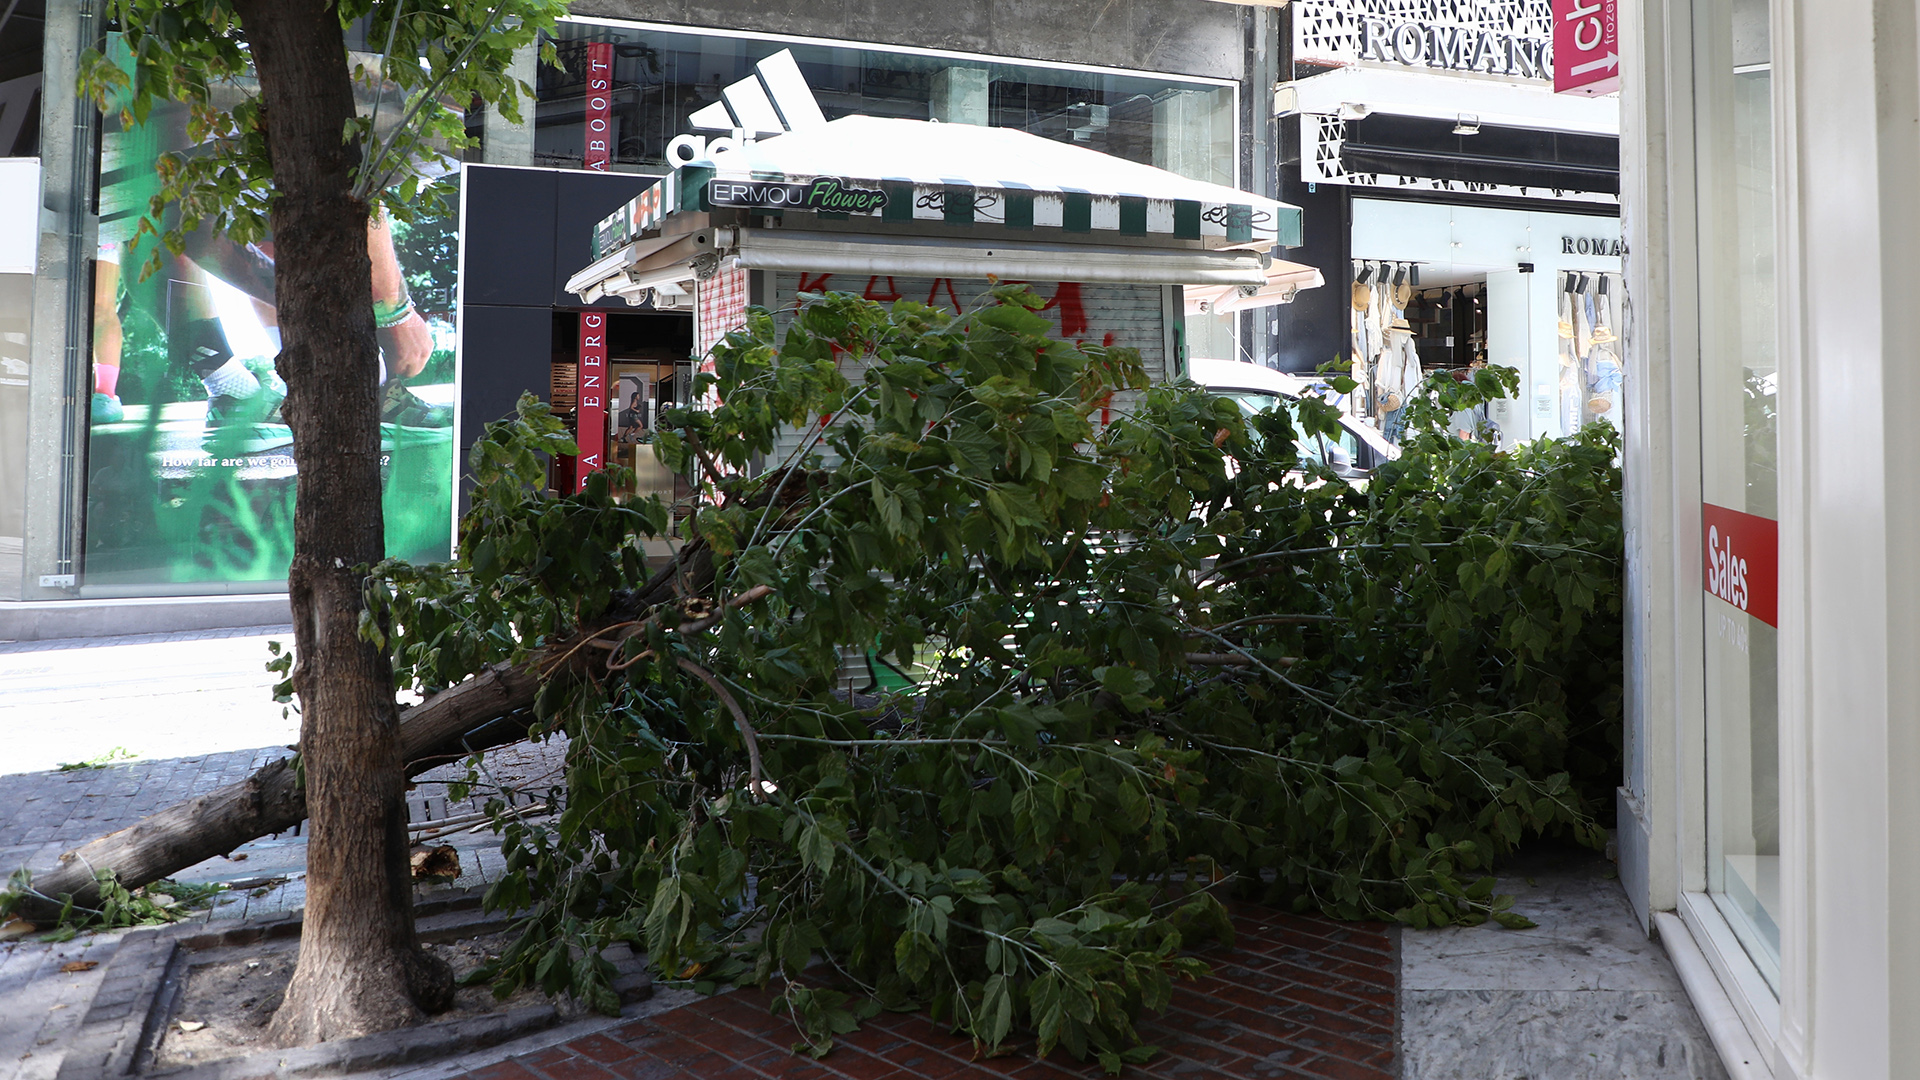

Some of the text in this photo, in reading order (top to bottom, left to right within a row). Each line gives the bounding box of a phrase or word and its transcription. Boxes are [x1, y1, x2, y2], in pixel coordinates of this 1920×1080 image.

[1604, 0, 1615, 45] froze
[590, 59, 607, 172] ABOOST
[714, 181, 884, 209] ERMOU Flower
[584, 314, 602, 408] ENERG
[162, 456, 195, 467] How
[198, 455, 219, 467] far
[221, 457, 243, 467] are
[247, 457, 267, 467] we
[1708, 524, 1748, 611] Sales
